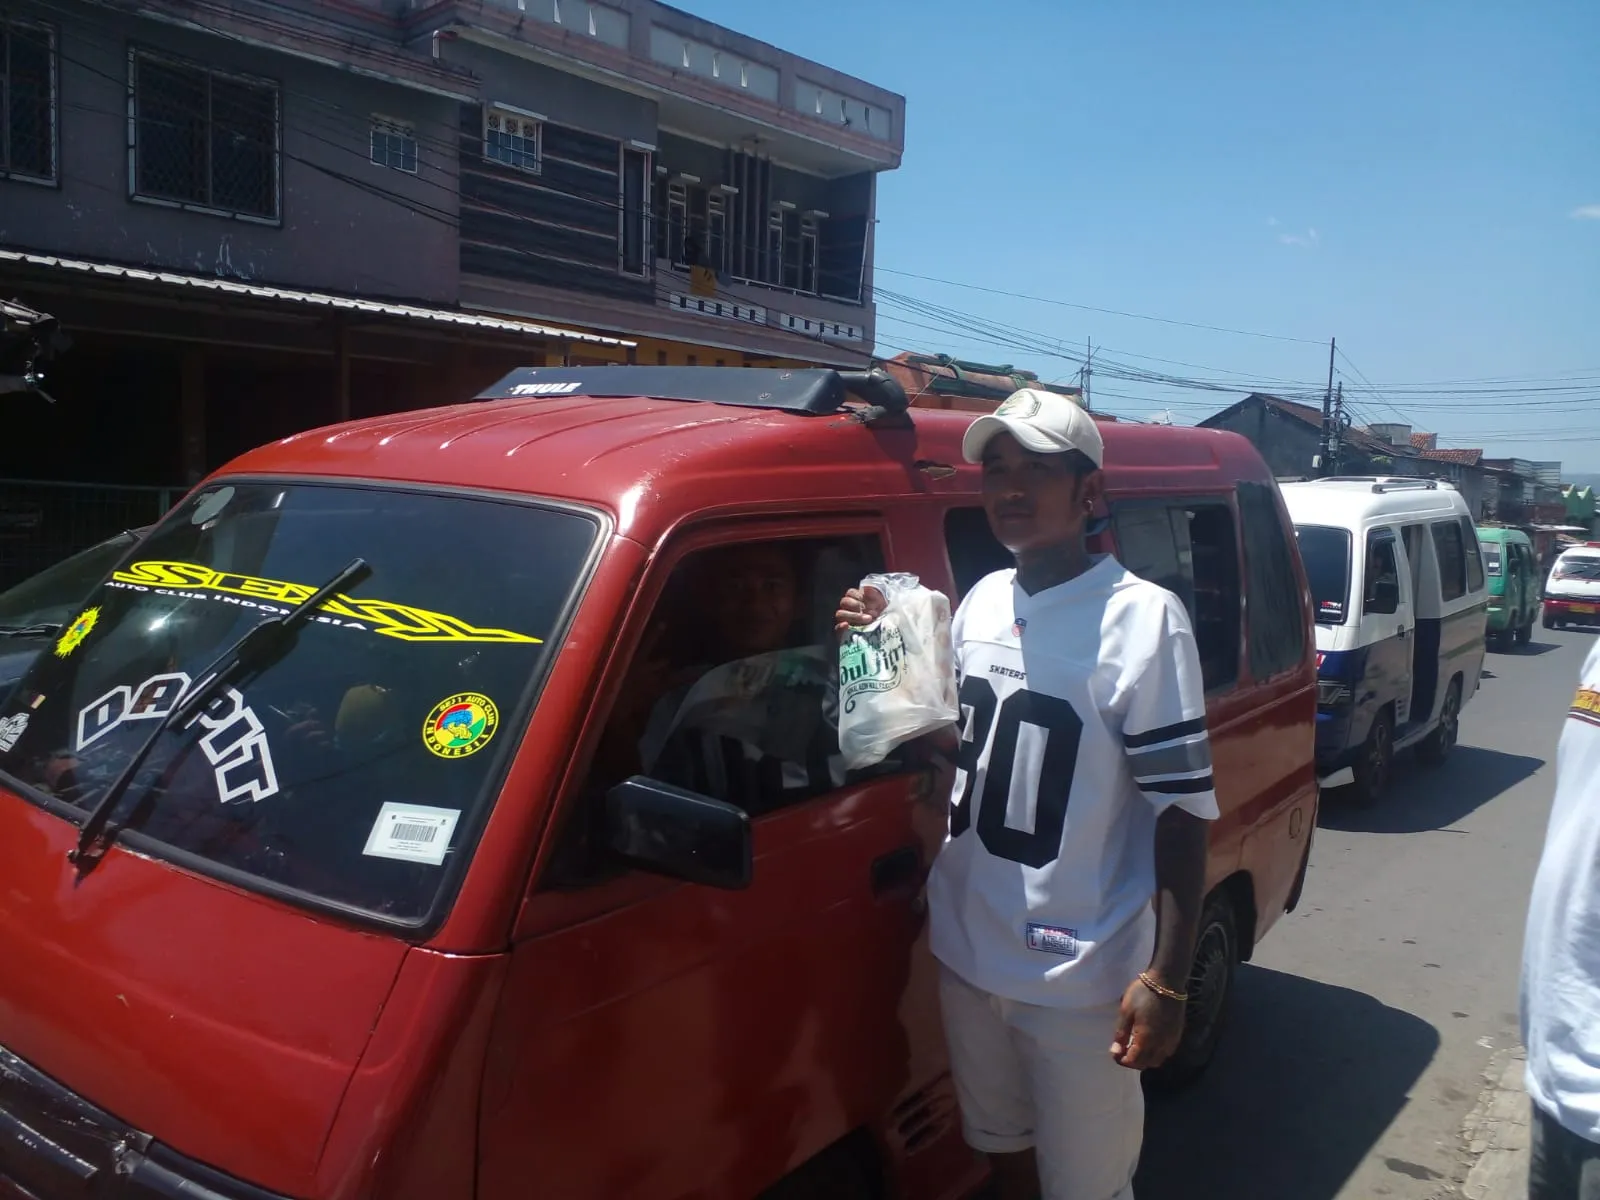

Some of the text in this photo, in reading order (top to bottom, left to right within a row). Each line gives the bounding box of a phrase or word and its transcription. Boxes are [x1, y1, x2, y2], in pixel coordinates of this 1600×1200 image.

[511, 382, 583, 395] THULE
[103, 581, 367, 631] AUTO CLUB INDONSIA
[989, 664, 1027, 680] SKATERS
[465, 695, 486, 707] AUTO
